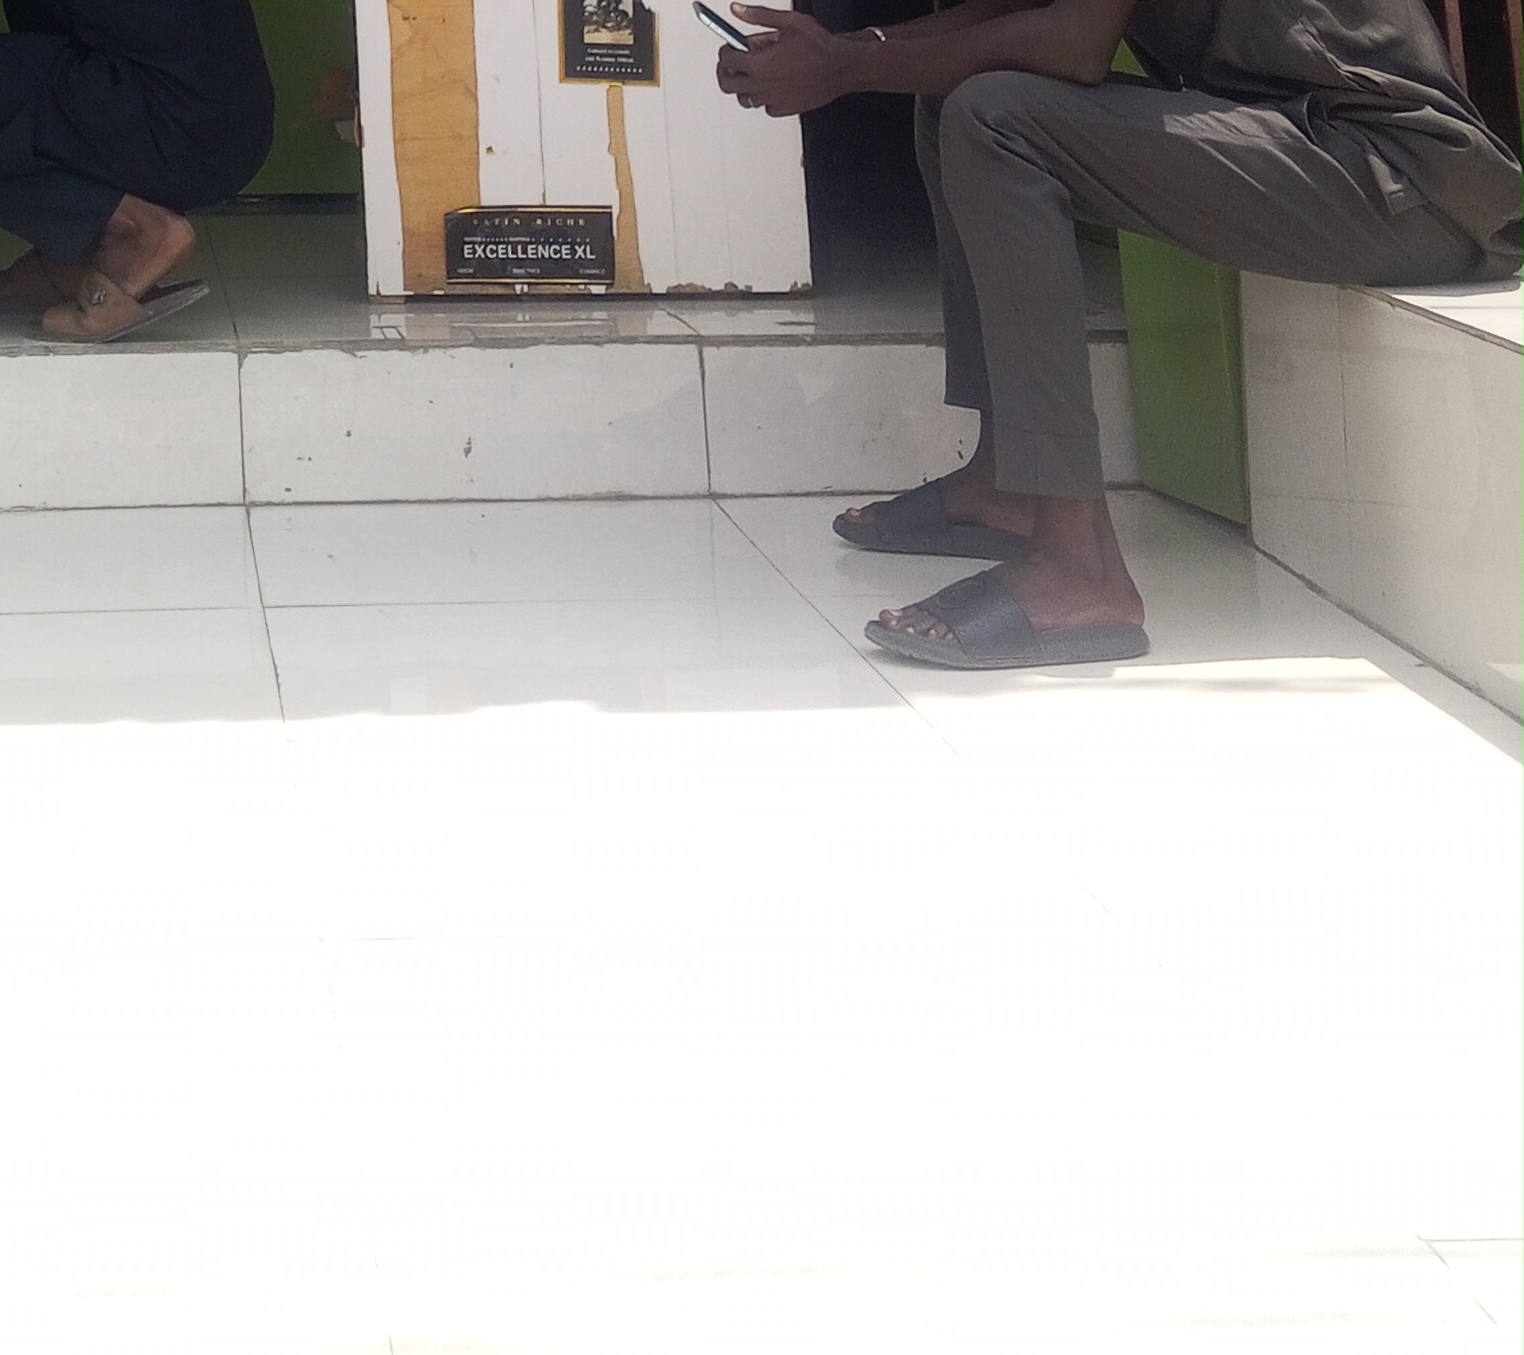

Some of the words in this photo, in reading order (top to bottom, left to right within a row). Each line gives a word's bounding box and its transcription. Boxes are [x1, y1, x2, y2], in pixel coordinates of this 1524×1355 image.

[535, 217, 586, 226] RICHE
[463, 244, 572, 260] EXCELLENCE
[574, 244, 596, 259] XL
